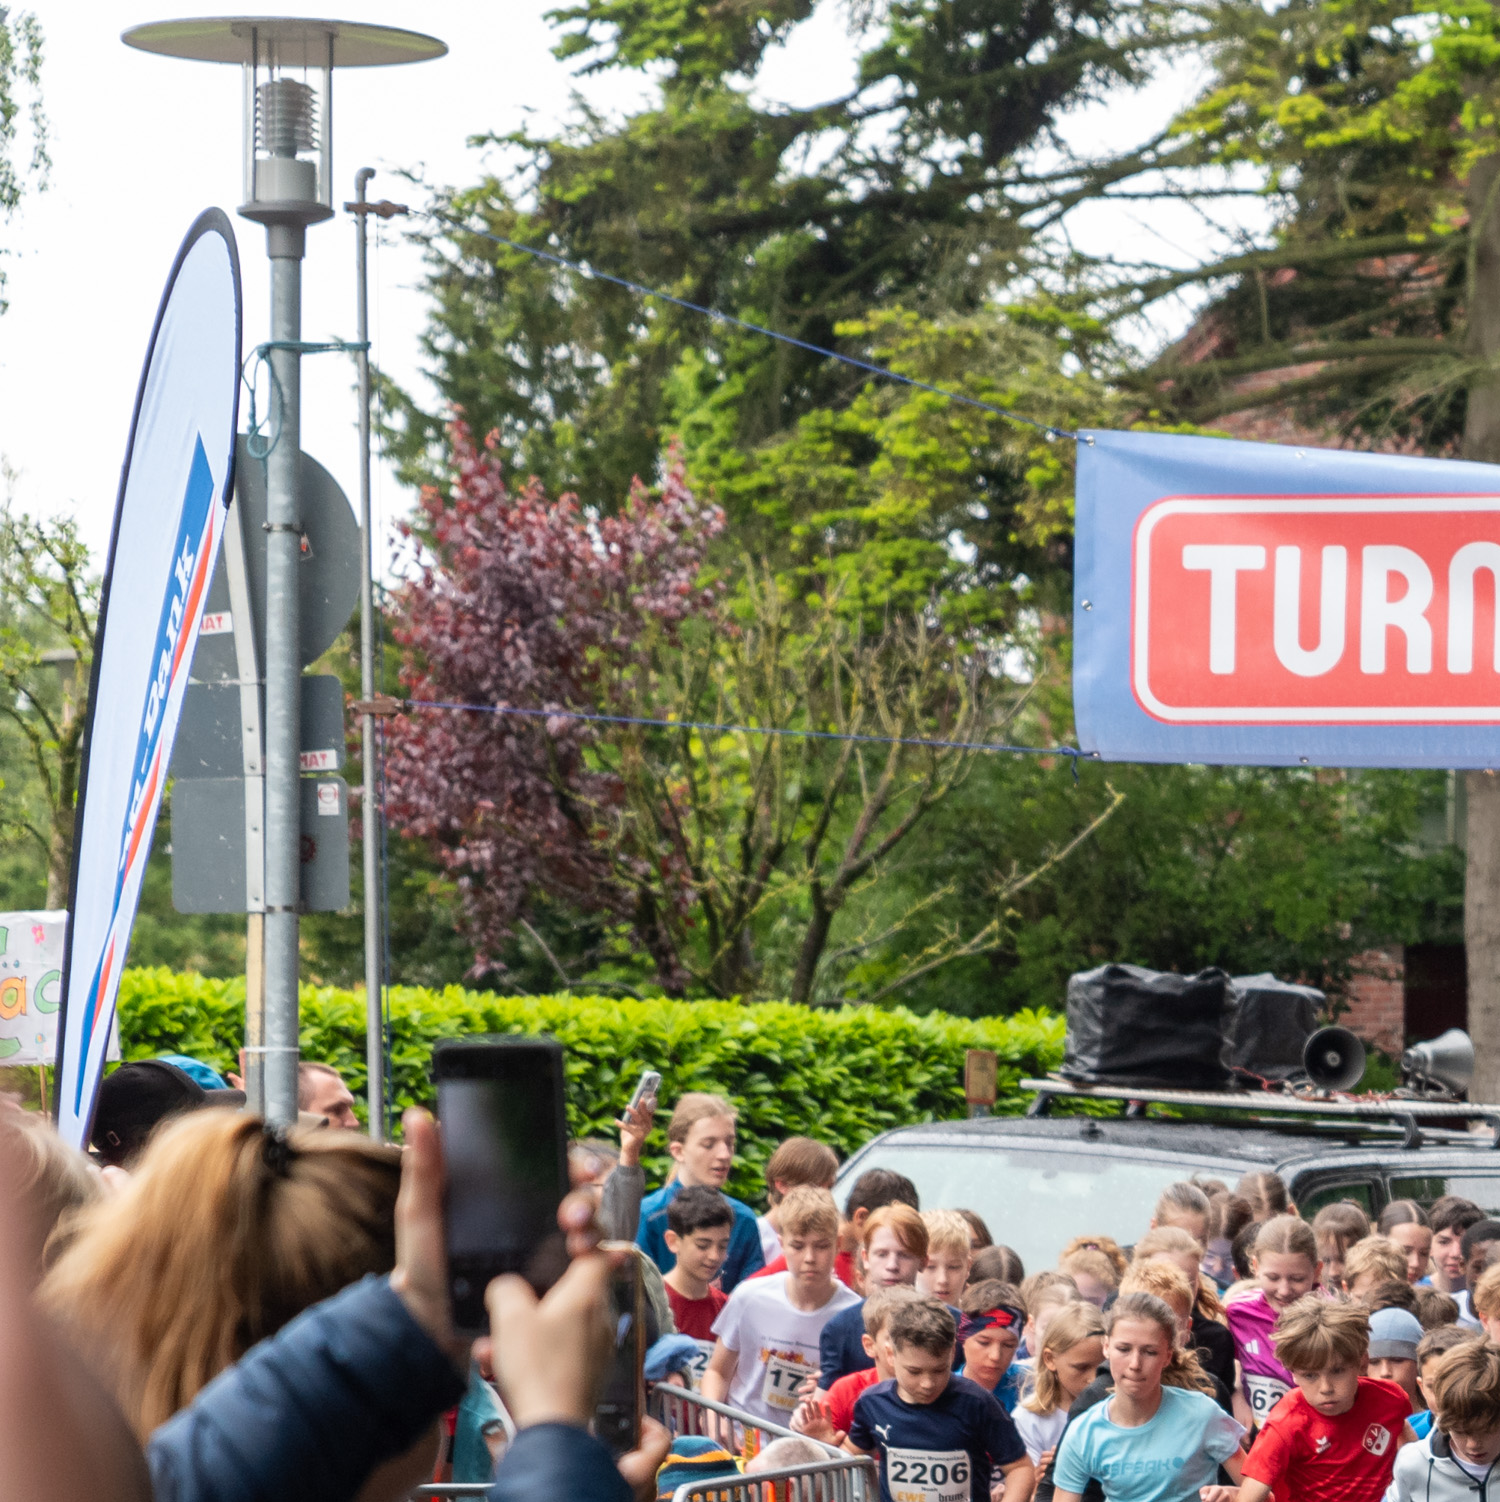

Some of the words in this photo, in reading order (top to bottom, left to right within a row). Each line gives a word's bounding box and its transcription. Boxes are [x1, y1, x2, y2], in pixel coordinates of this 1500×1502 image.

[770, 1369, 805, 1392] 17
[1252, 1389, 1285, 1412] 62
[890, 1460, 969, 1486] 2206
[938, 1492, 965, 1502] bruns
